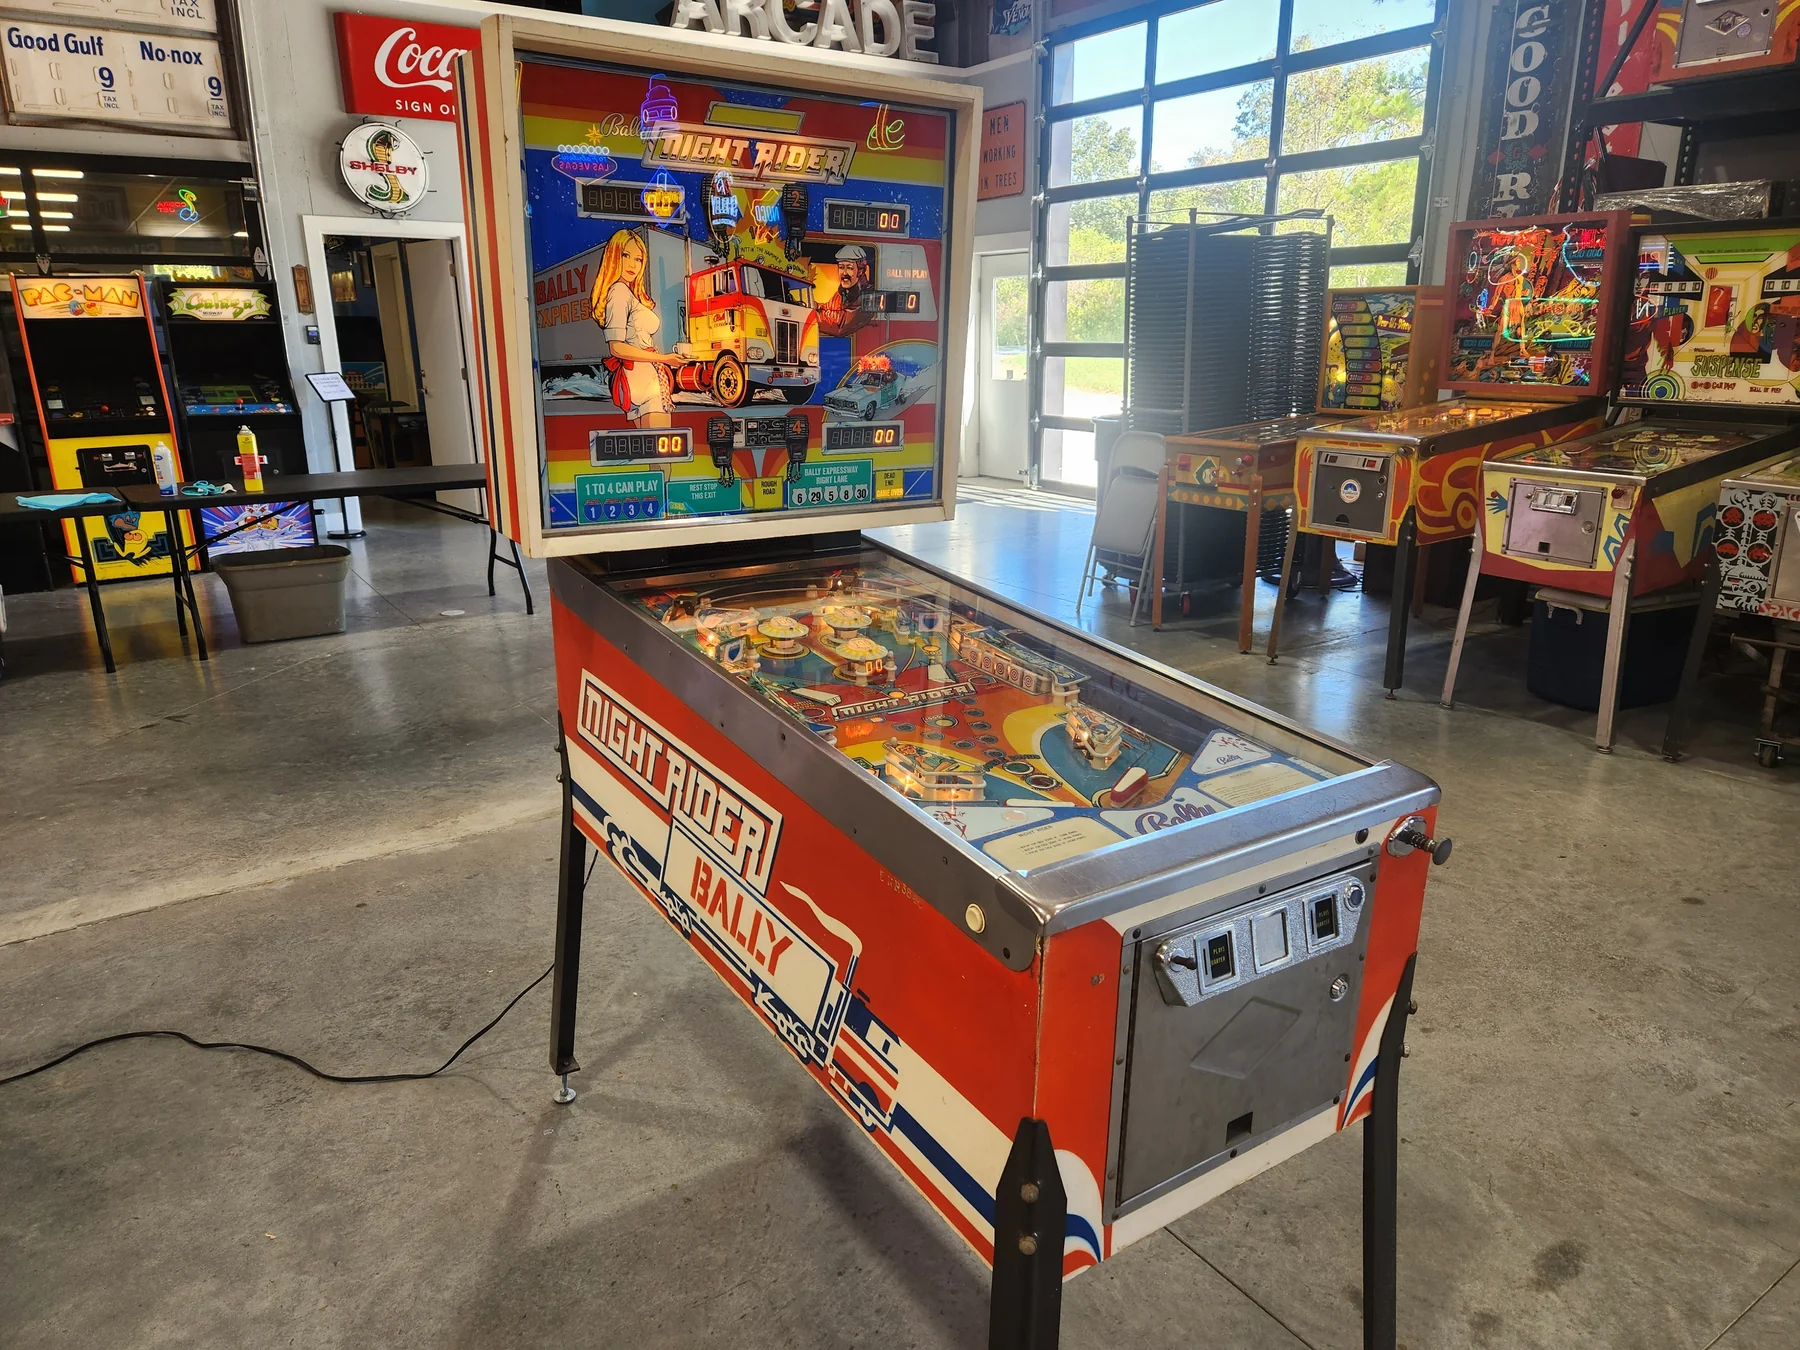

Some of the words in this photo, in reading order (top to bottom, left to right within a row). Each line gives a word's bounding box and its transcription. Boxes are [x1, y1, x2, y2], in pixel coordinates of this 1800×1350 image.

[672, 0, 939, 63] ARCADE
[7, 27, 60, 52] Good
[64, 33, 104, 56] Gulf
[98, 67, 114, 88] 9
[207, 77, 222, 96] 9
[395, 100, 432, 113] SIGN
[989, 115, 1009, 135] MEN
[660, 133, 750, 166] NIGHT
[754, 142, 845, 184] RIDER
[983, 145, 1016, 163] WORKING
[350, 160, 418, 176] SHELBY
[996, 172, 1017, 188] TREES
[886, 268, 902, 278] BALL
[904, 269, 911, 278] IN
[912, 269, 928, 279] PLAY
[535, 264, 588, 305] BALLY
[20, 283, 139, 309] PAC-MAN
[185, 292, 254, 319] Galaga
[1691, 354, 1763, 379] SUSPENSE
[717, 422, 726, 438] 3
[804, 467, 821, 476] BALLY
[822, 465, 859, 474] EXPRESSWAY
[884, 472, 895, 480] DEAD
[585, 483, 590, 496] 1
[591, 483, 606, 495] TO
[607, 483, 613, 494] 4
[616, 481, 634, 493] CAN
[636, 480, 659, 492] PLAY
[703, 483, 718, 491] STOP
[816, 477, 832, 485] RIGHT
[833, 475, 848, 483] LANE
[691, 492, 704, 500] THIS
[704, 491, 716, 499] EXIT
[797, 493, 803, 504] 6
[810, 491, 821, 502] 29
[828, 491, 834, 502] 5
[844, 490, 849, 500] 8
[857, 488, 867, 499] 30
[876, 489, 890, 498] GAME
[890, 488, 904, 497] OVER
[590, 507, 596, 519] 1
[609, 505, 616, 517] 2
[628, 504, 635, 516] 3
[647, 503, 653, 514] 4
[840, 698, 899, 716] NIGHT
[904, 685, 968, 706] RIDER
[1216, 754, 1243, 765] Bally
[585, 686, 664, 783] NIGHT
[666, 747, 767, 878] RIDER
[690, 856, 794, 976] BALLY
[1211, 955, 1226, 966] UARTER
